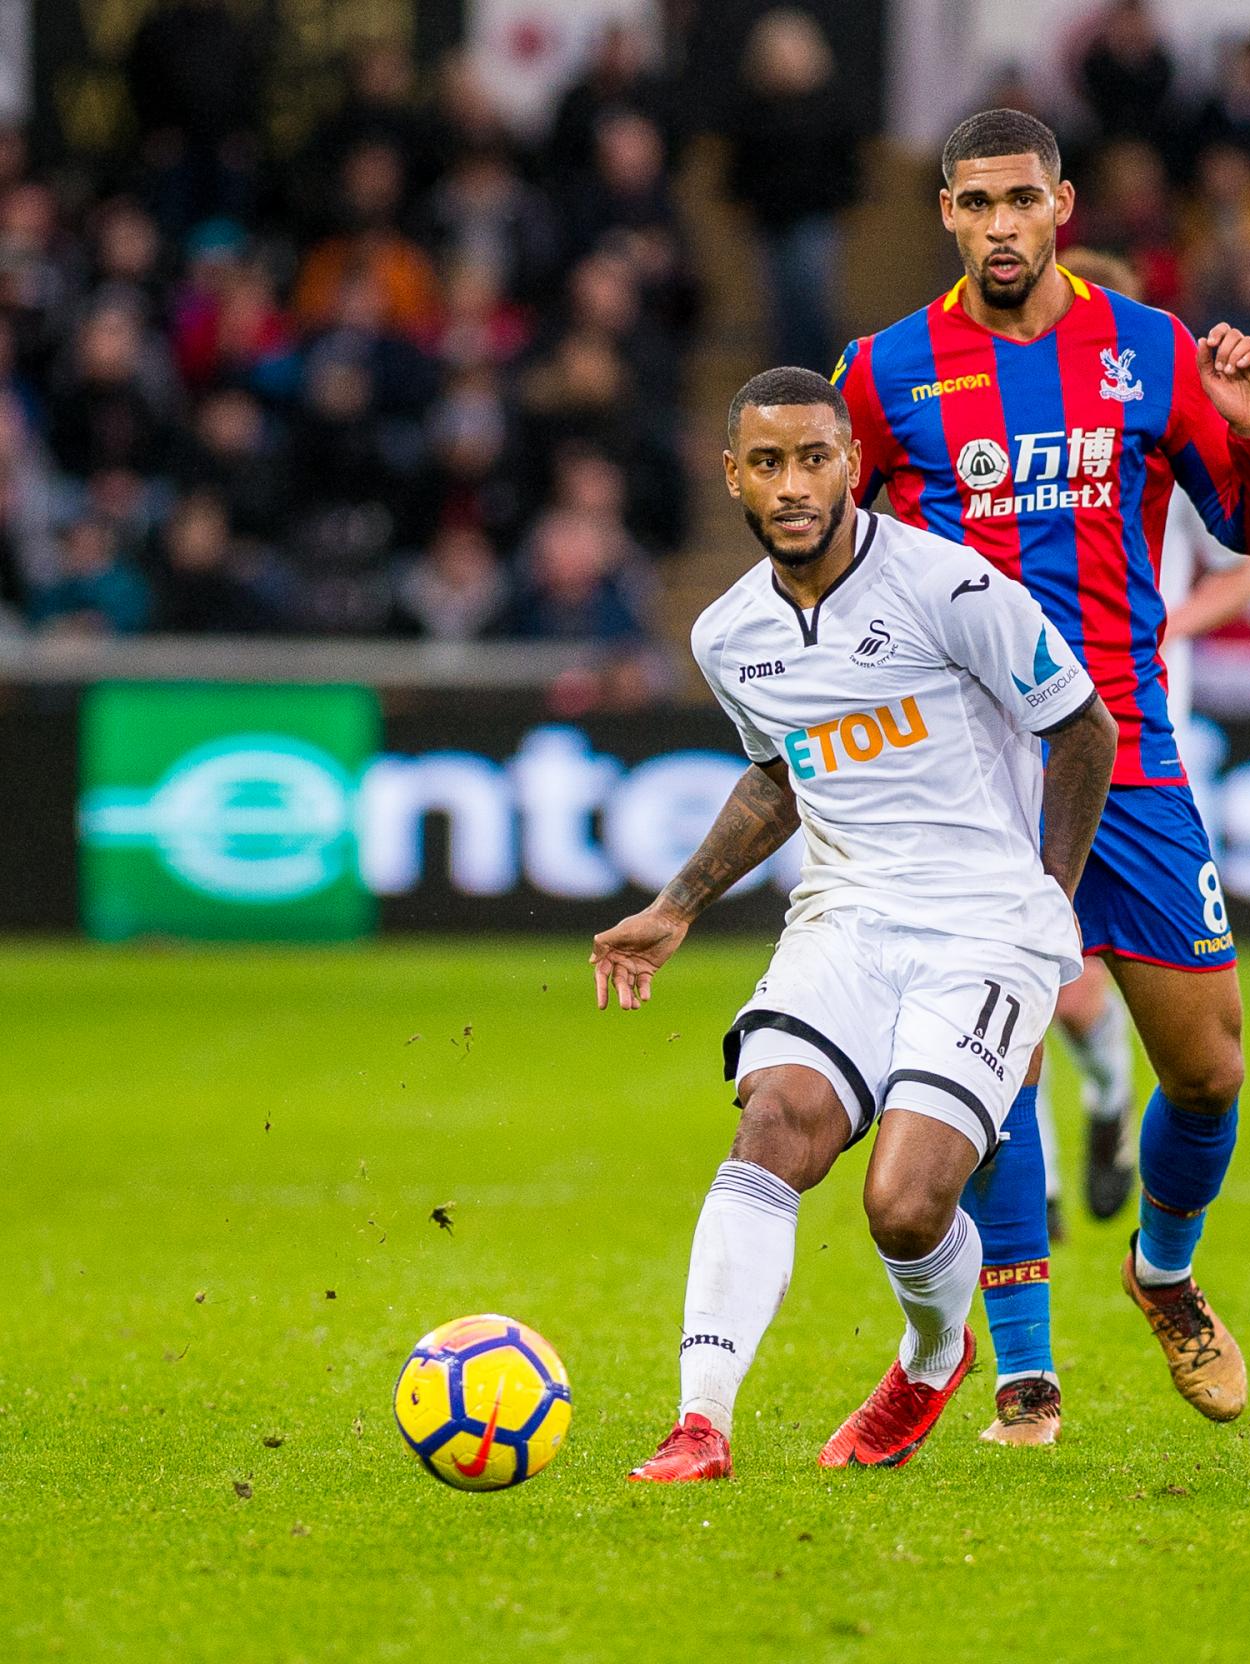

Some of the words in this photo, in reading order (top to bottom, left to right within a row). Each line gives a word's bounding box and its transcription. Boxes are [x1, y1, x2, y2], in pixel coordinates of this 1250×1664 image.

[912, 373, 991, 401] macron
[1014, 427, 1115, 483] 万博
[965, 481, 1114, 519] ManBetX
[784, 695, 929, 780] ETOU
[1197, 861, 1228, 934] 8
[973, 979, 1020, 1058] 11
[986, 1265, 1041, 1286] CPFC
